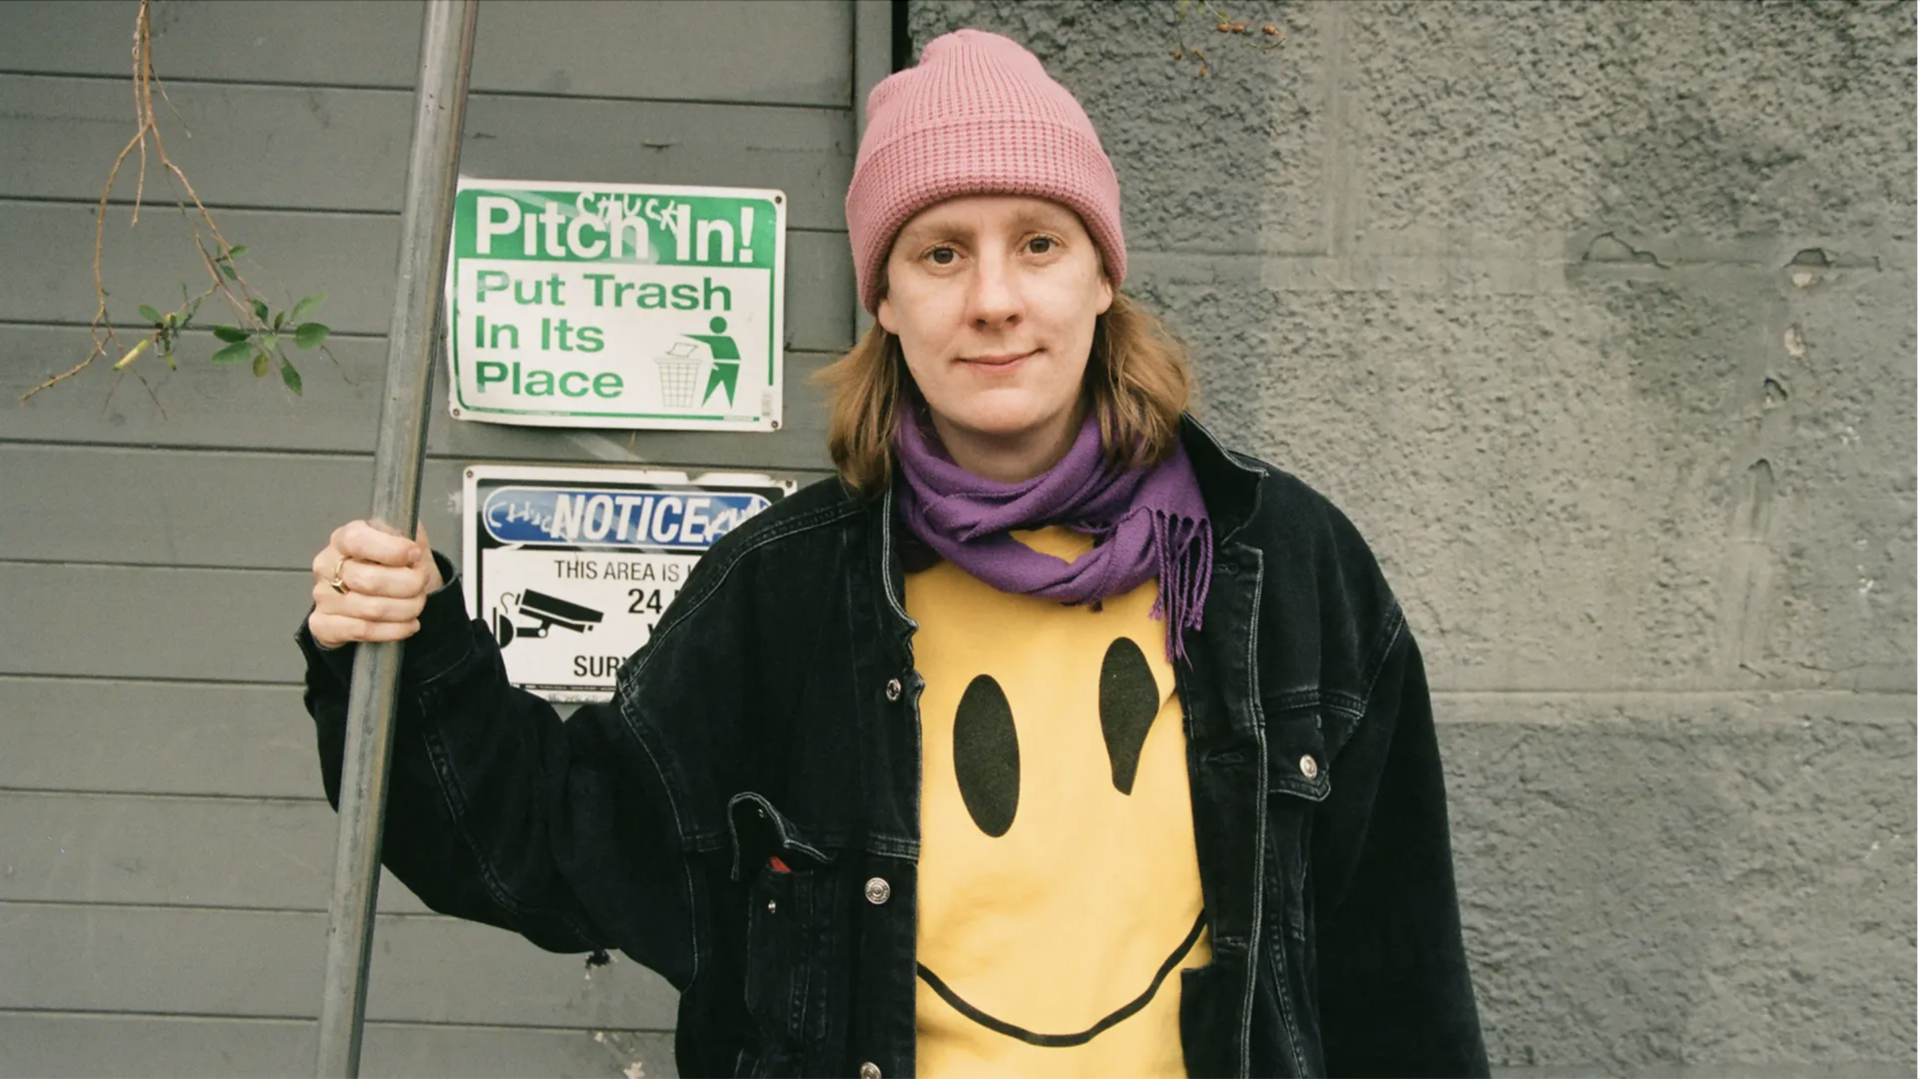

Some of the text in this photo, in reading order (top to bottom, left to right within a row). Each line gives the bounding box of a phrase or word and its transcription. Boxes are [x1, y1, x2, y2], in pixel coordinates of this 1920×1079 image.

[476, 196, 754, 263] Pitch In!
[476, 270, 732, 311] Put Trash
[476, 316, 605, 353] In Its
[476, 361, 624, 399] Place
[550, 494, 711, 543] NOTICE
[554, 560, 598, 580] THIS
[603, 561, 656, 581] AREA
[662, 563, 680, 582] IS
[628, 588, 663, 615] 24
[573, 655, 627, 677] SUR
